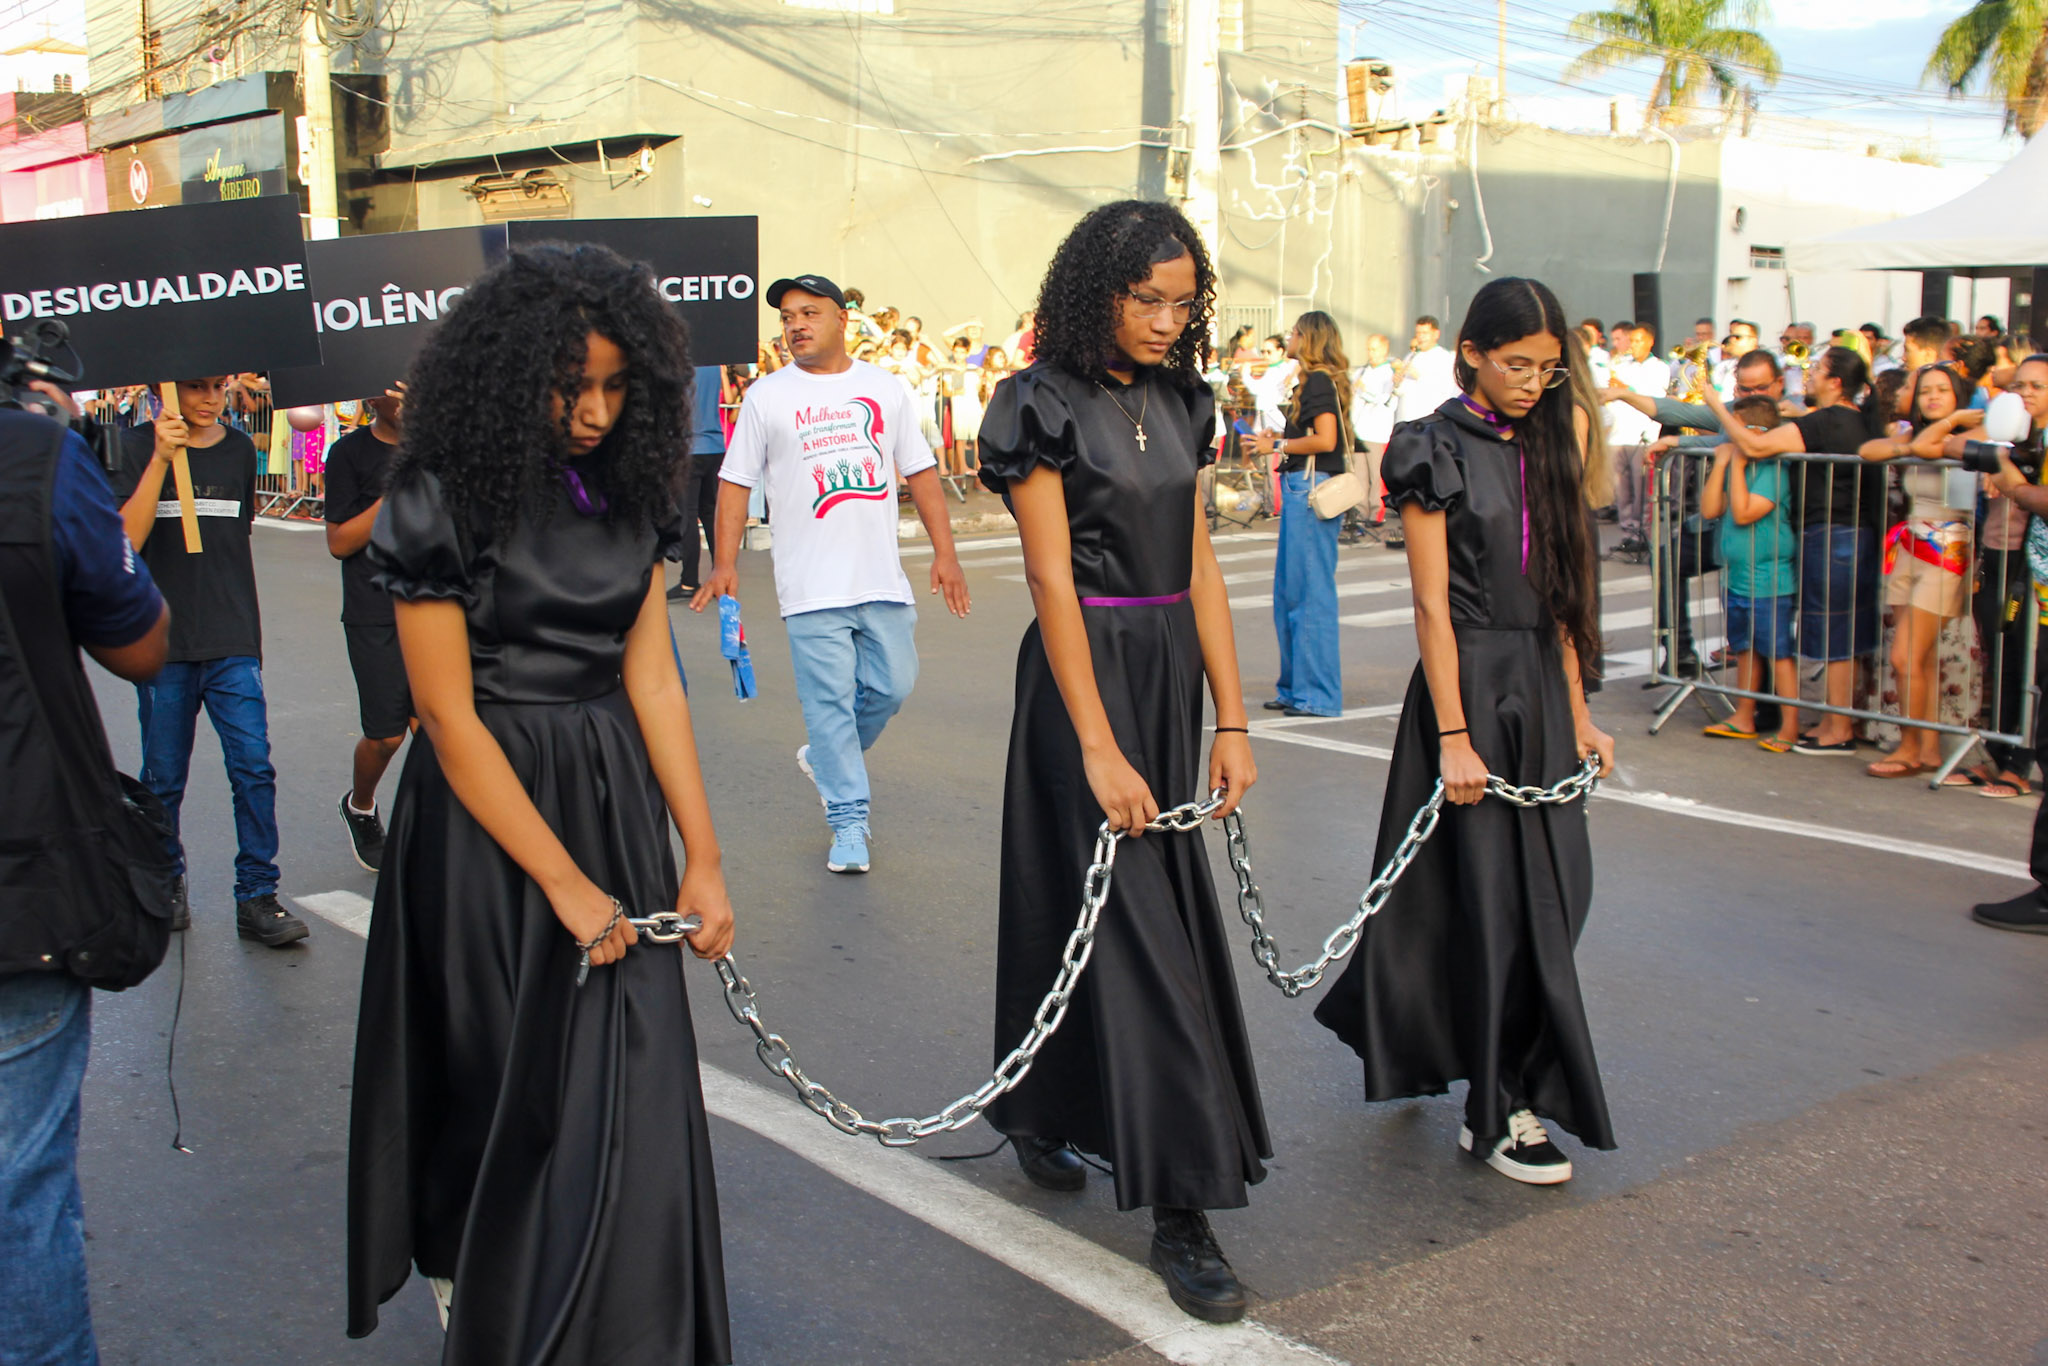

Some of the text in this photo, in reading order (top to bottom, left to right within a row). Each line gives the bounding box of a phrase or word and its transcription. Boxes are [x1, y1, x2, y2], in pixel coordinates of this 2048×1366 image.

[220, 177, 261, 201] RIBEIRO
[1, 263, 306, 321] DESIGUALDADE
[659, 274, 755, 302] CEITO
[312, 282, 466, 333] IOLÊNC
[795, 406, 852, 430] Mulheres
[803, 441, 811, 453] A
[812, 432, 858, 450] HISTÓRIA
